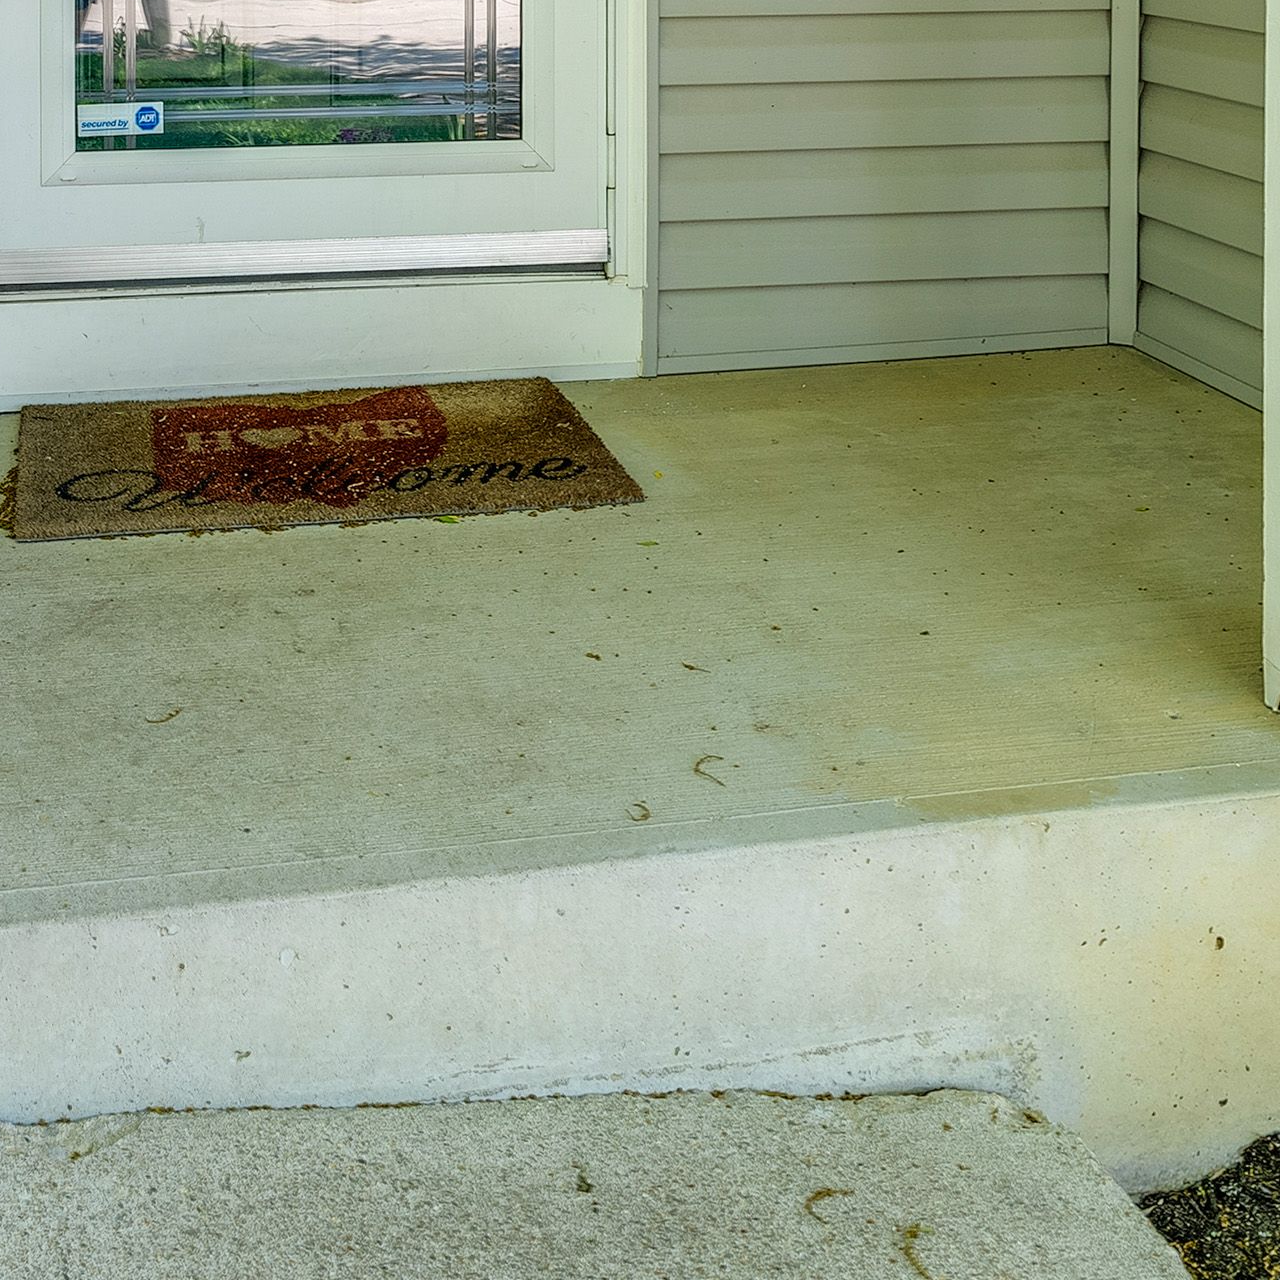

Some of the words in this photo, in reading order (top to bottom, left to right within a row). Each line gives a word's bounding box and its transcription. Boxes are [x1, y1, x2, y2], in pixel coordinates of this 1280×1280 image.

[140, 113, 156, 122] ADT
[81, 119, 116, 129] secured
[117, 119, 129, 128] by
